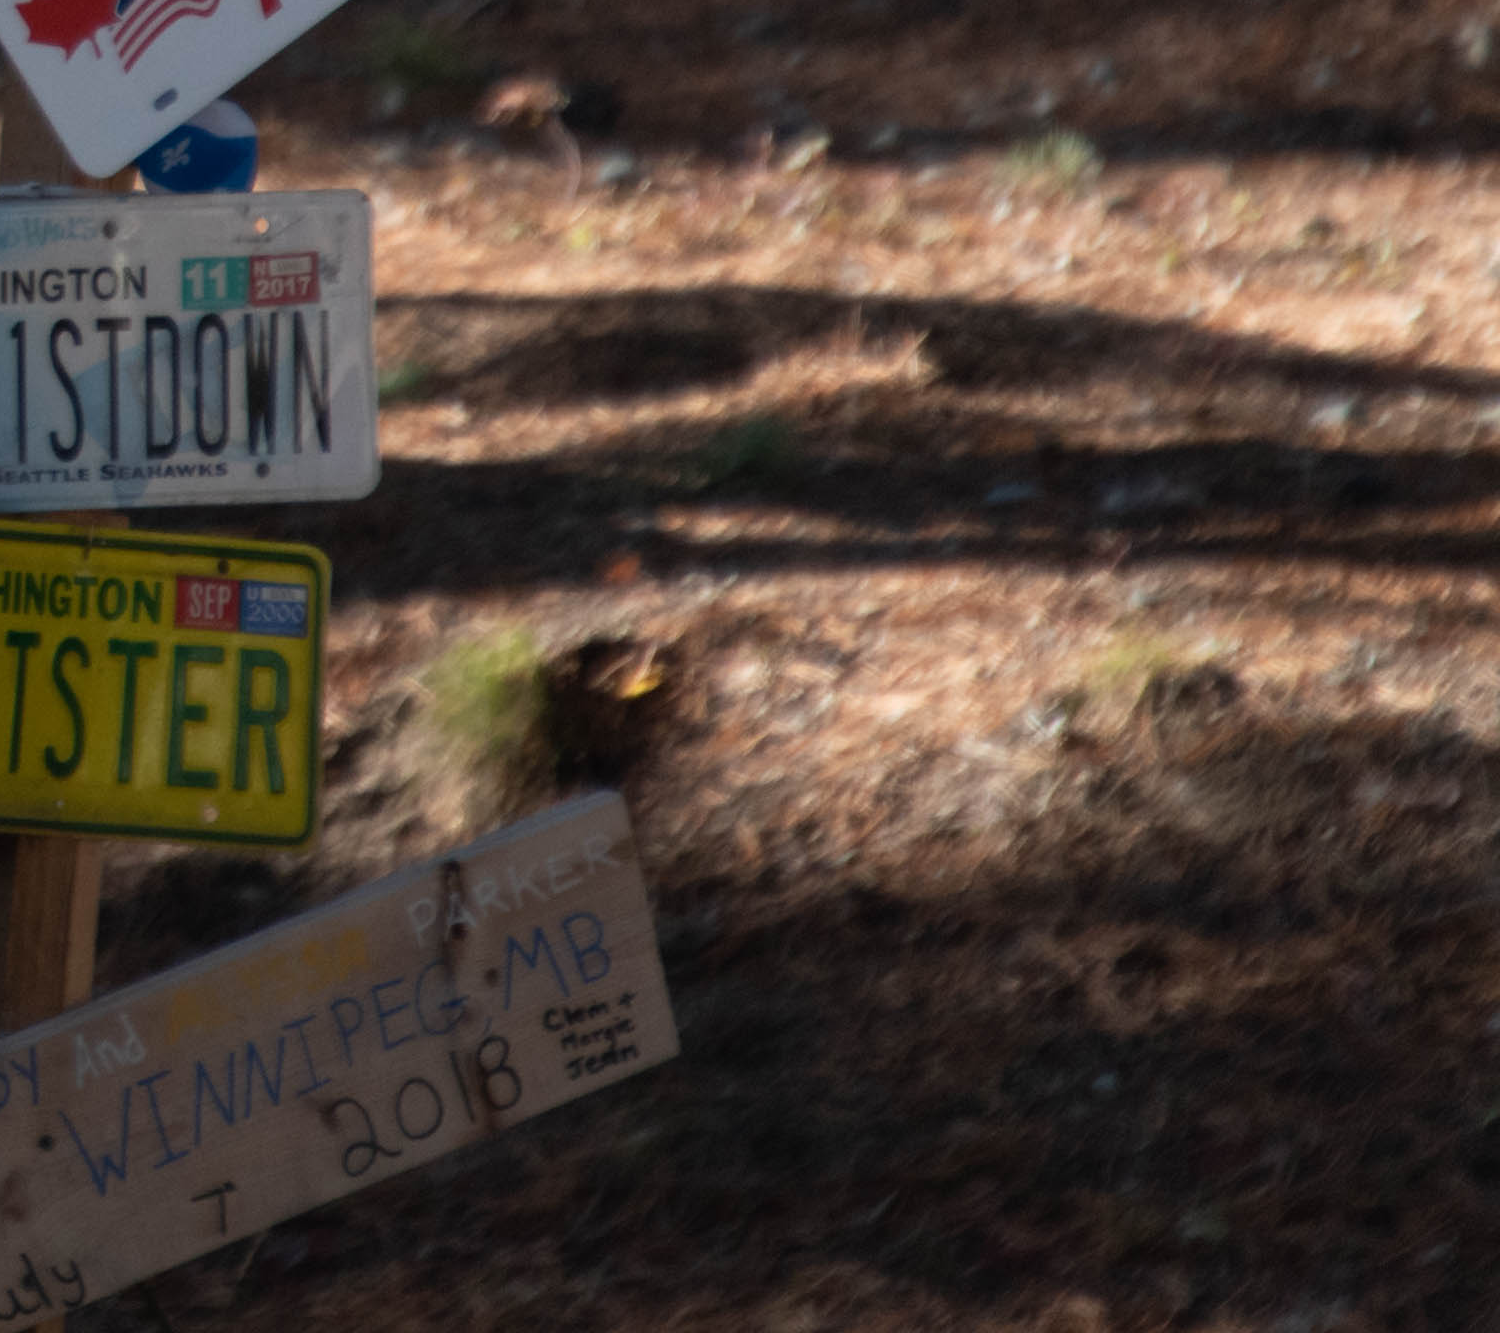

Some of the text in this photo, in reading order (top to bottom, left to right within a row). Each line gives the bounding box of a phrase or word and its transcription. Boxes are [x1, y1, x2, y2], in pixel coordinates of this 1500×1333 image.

[186, 262, 231, 302] 11
[254, 274, 314, 301] 2017
[9, 309, 336, 464] 1STDOWN
[99, 460, 231, 484] SEAHAWKS
[187, 579, 233, 622] SEP
[403, 829, 621, 952] PARKER
[503, 908, 613, 1011] MB
[341, 1033, 524, 1179] 2018
